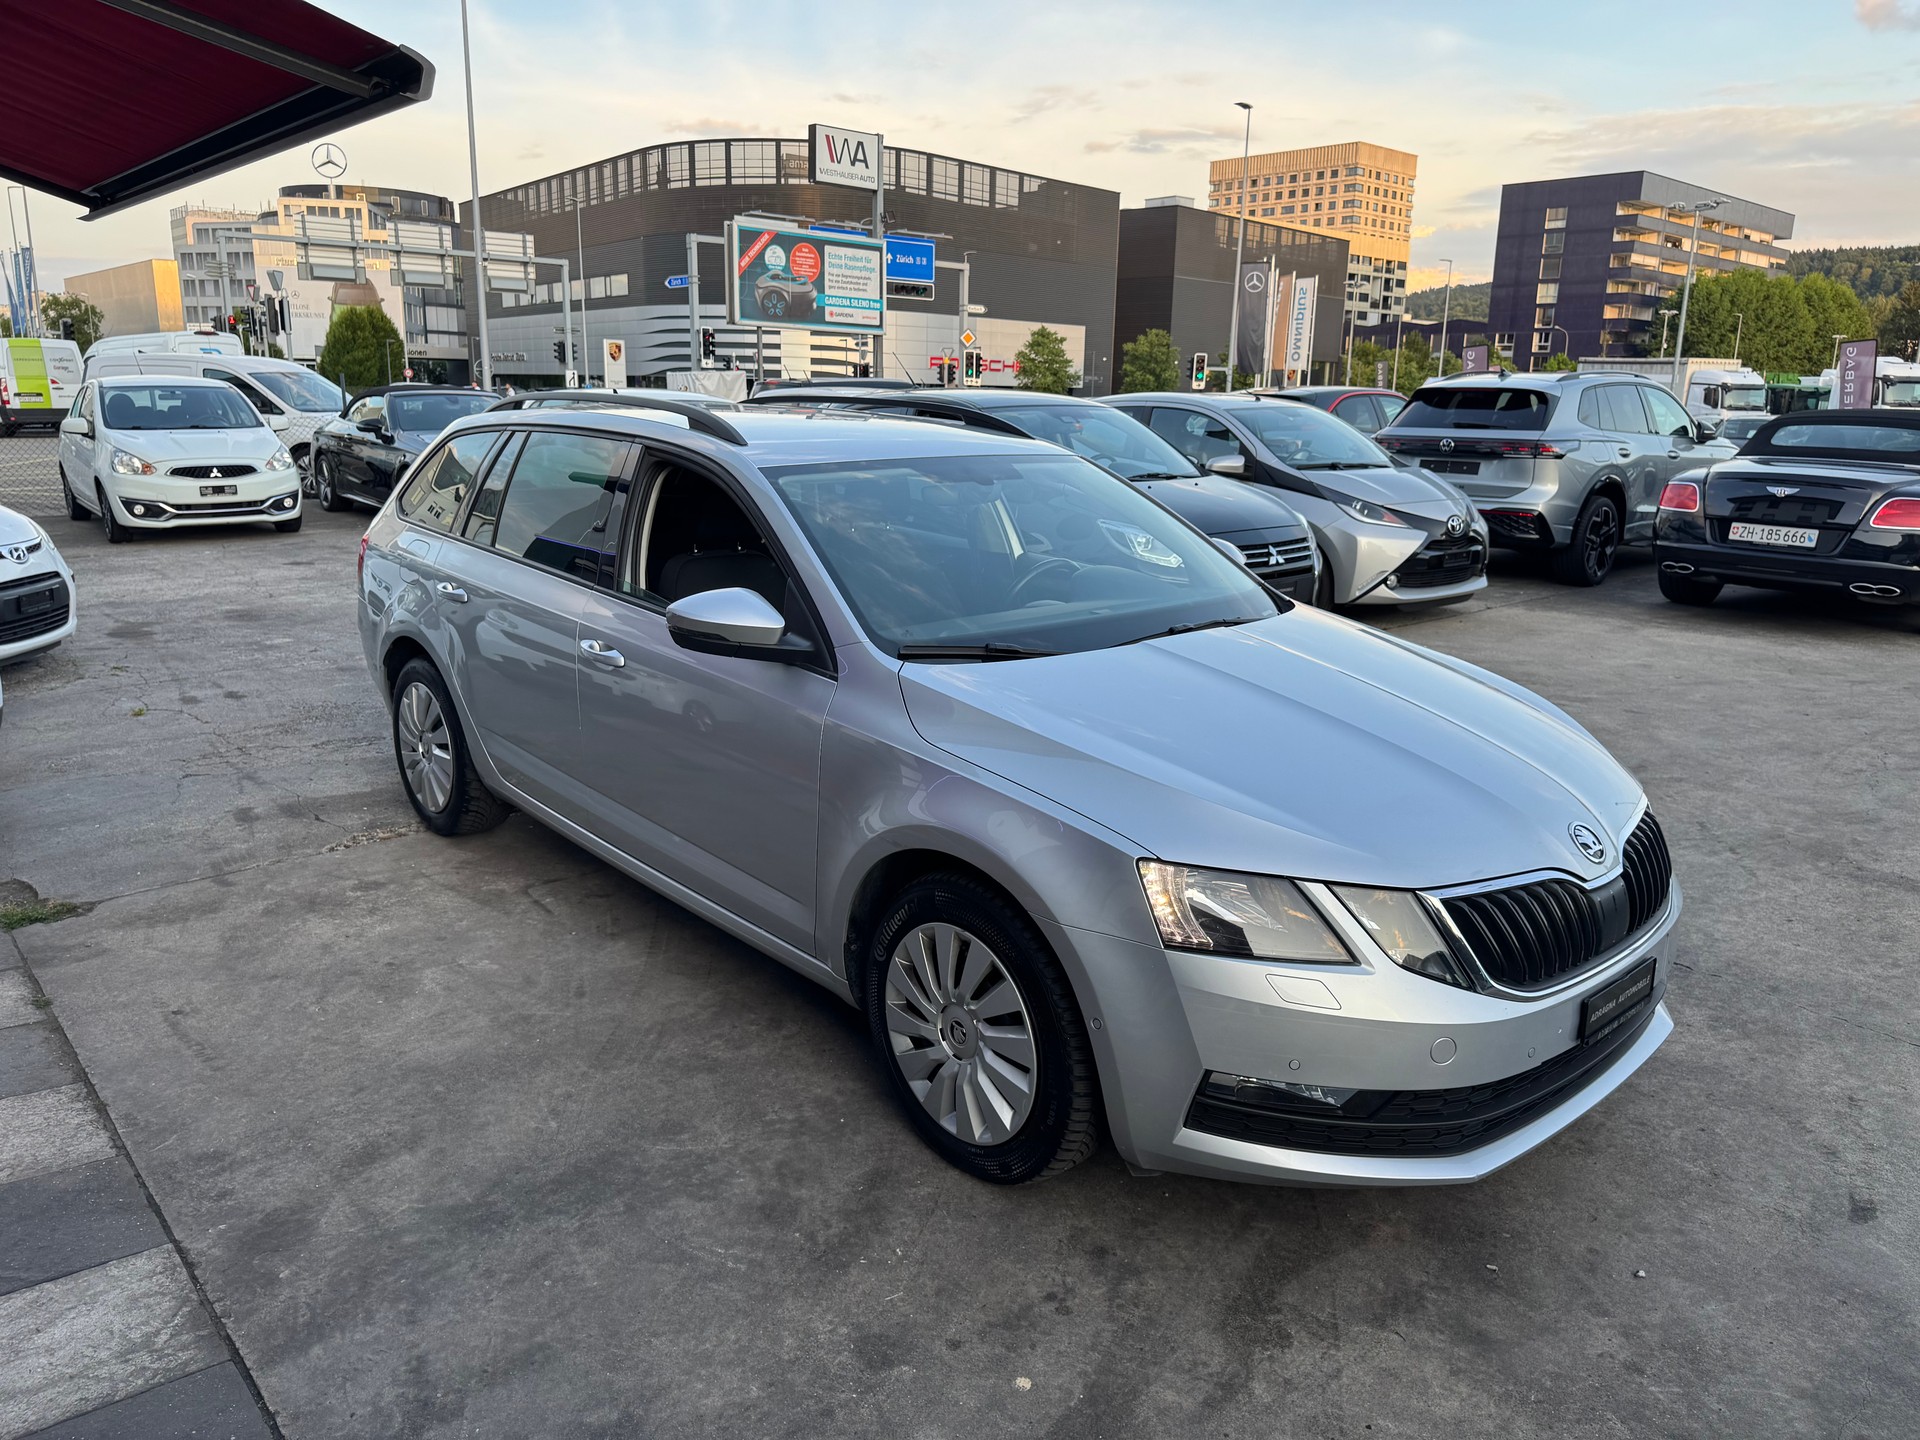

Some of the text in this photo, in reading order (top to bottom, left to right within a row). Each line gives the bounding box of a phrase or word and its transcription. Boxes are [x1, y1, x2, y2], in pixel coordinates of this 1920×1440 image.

[819, 168, 875, 183] WESTHAUSER AUTO
[828, 252, 843, 260] Echte
[844, 254, 864, 263] Freiheit
[896, 254, 914, 264] Zürich
[828, 261, 843, 270] Deine
[825, 296, 880, 309] GARDENA SILENO free
[1590, 975, 1651, 1023] ADRAGNA AUTOMOBILE
